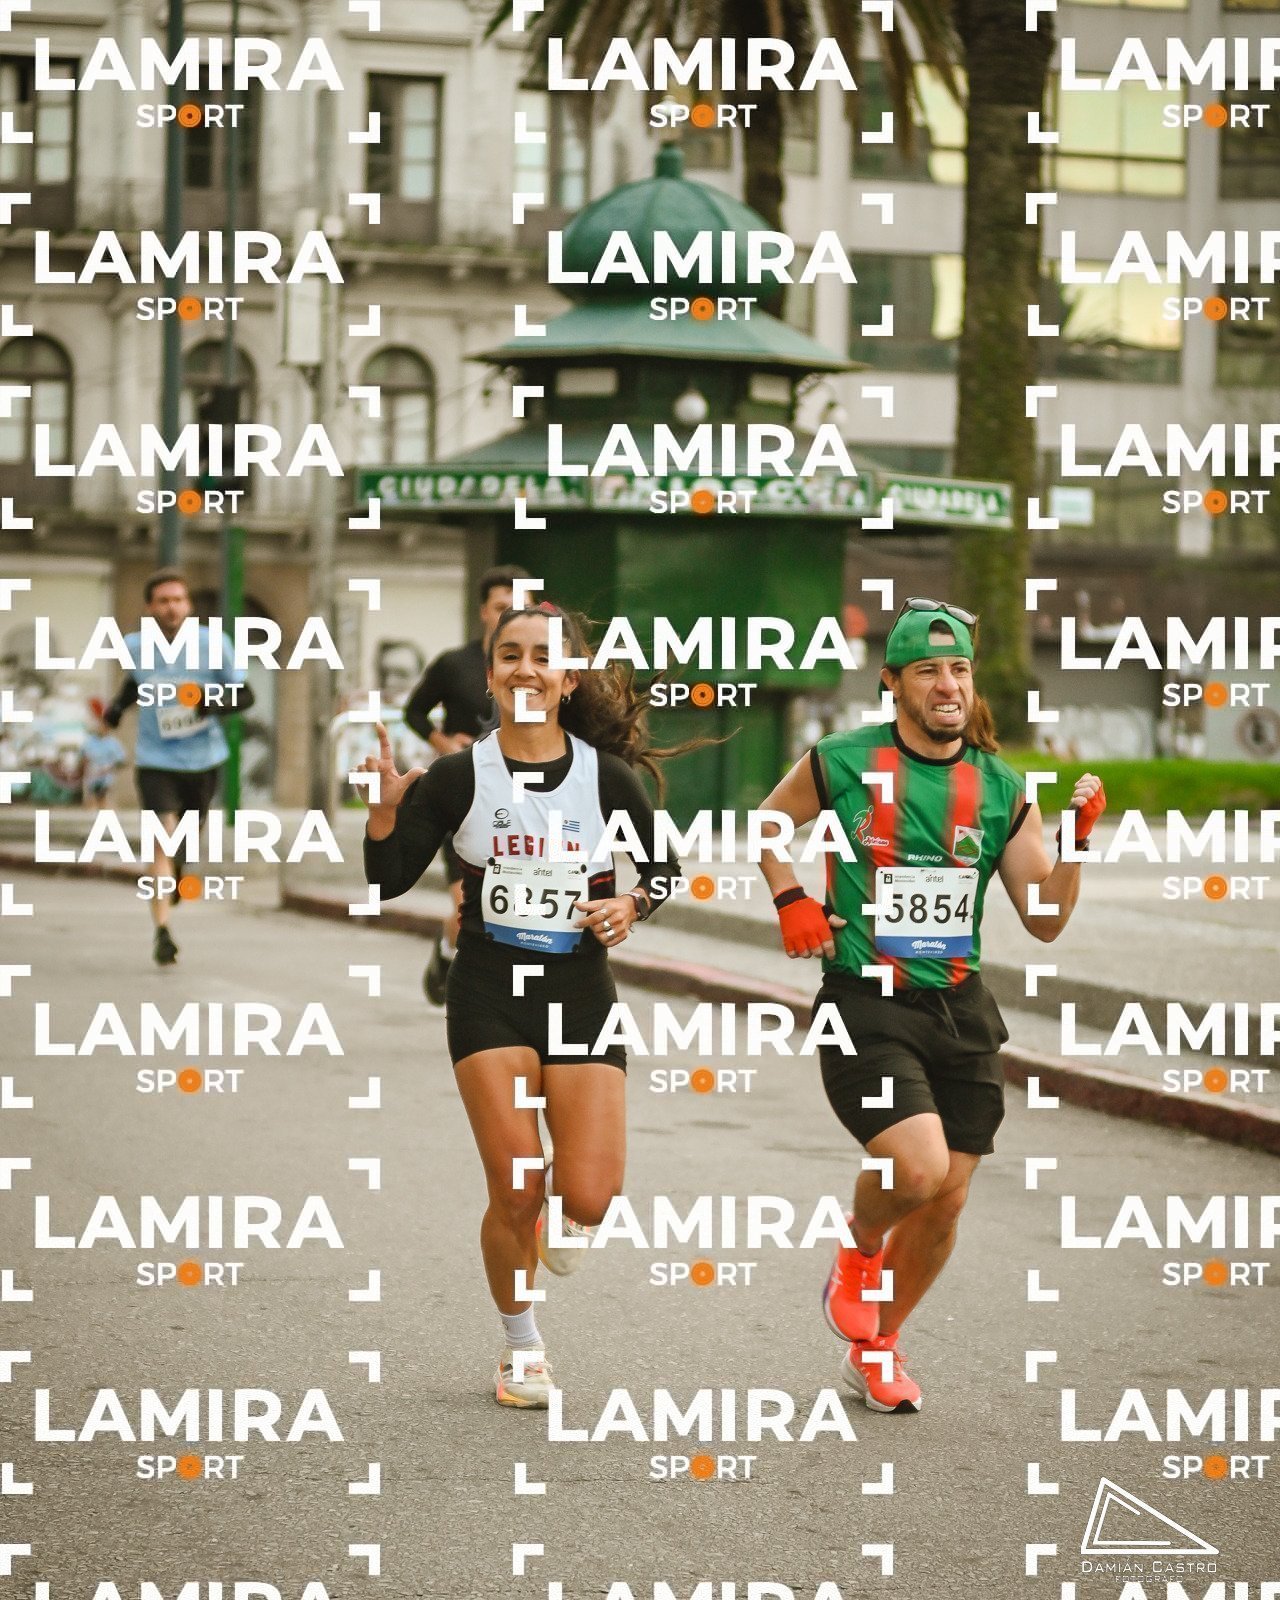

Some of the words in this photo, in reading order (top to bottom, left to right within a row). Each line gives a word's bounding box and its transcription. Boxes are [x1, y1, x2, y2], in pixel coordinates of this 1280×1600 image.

[493, 835, 580, 858] LEGIN
[907, 853, 943, 863] RHINO
[884, 893, 969, 924] 5854
